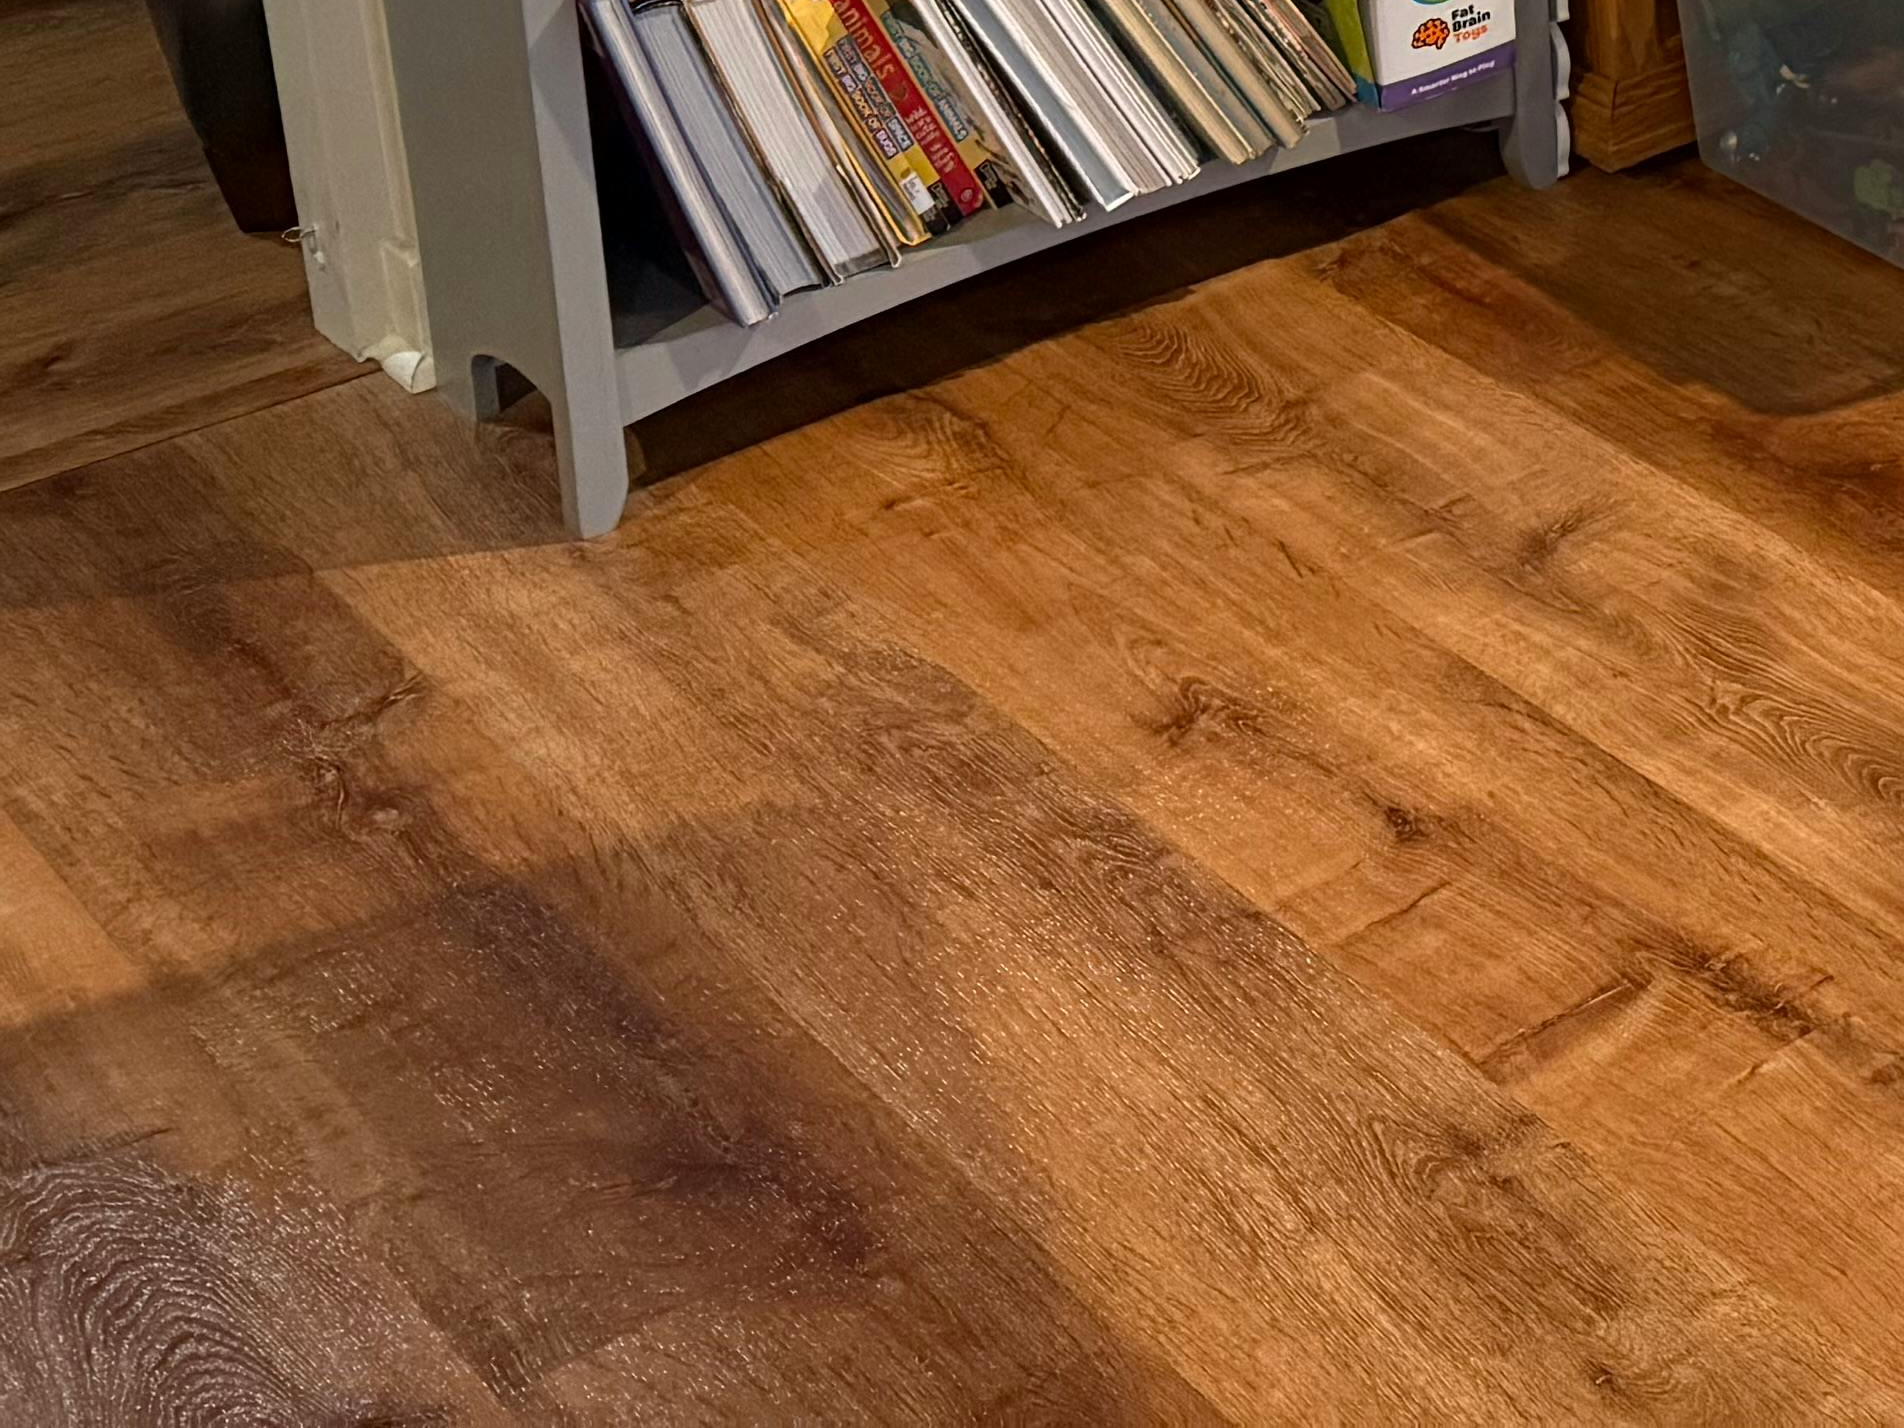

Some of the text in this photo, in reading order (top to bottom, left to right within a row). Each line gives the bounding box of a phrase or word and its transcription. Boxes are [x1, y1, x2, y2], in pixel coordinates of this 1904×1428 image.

[1451, 4, 1476, 22] Fat
[1452, 9, 1492, 34] Brain
[1453, 25, 1490, 43] Toys
